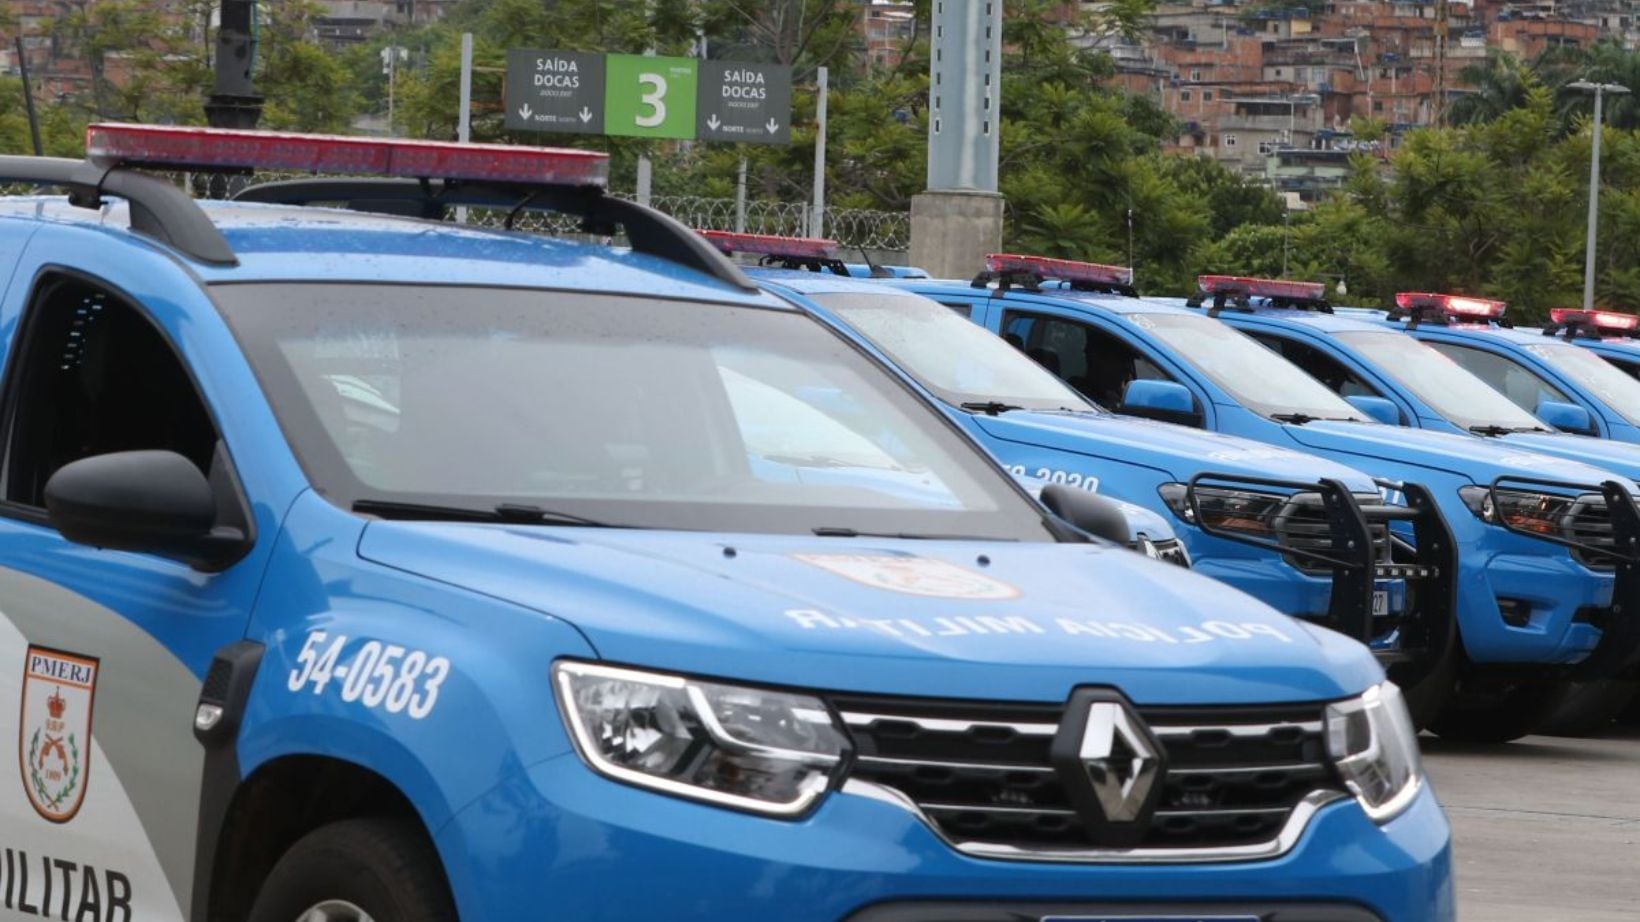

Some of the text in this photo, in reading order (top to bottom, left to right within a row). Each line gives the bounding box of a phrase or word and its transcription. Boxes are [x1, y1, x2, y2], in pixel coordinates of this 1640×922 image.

[536, 56, 578, 73] SAÍDA
[534, 73, 580, 88] DOCAS
[724, 68, 765, 84] SAÍDA
[635, 73, 668, 127] 3
[722, 85, 766, 99] DOCAS
[31, 656, 92, 684] PMERJ
[288, 630, 450, 720] 54-0583
[0, 847, 132, 922] ILITAR
